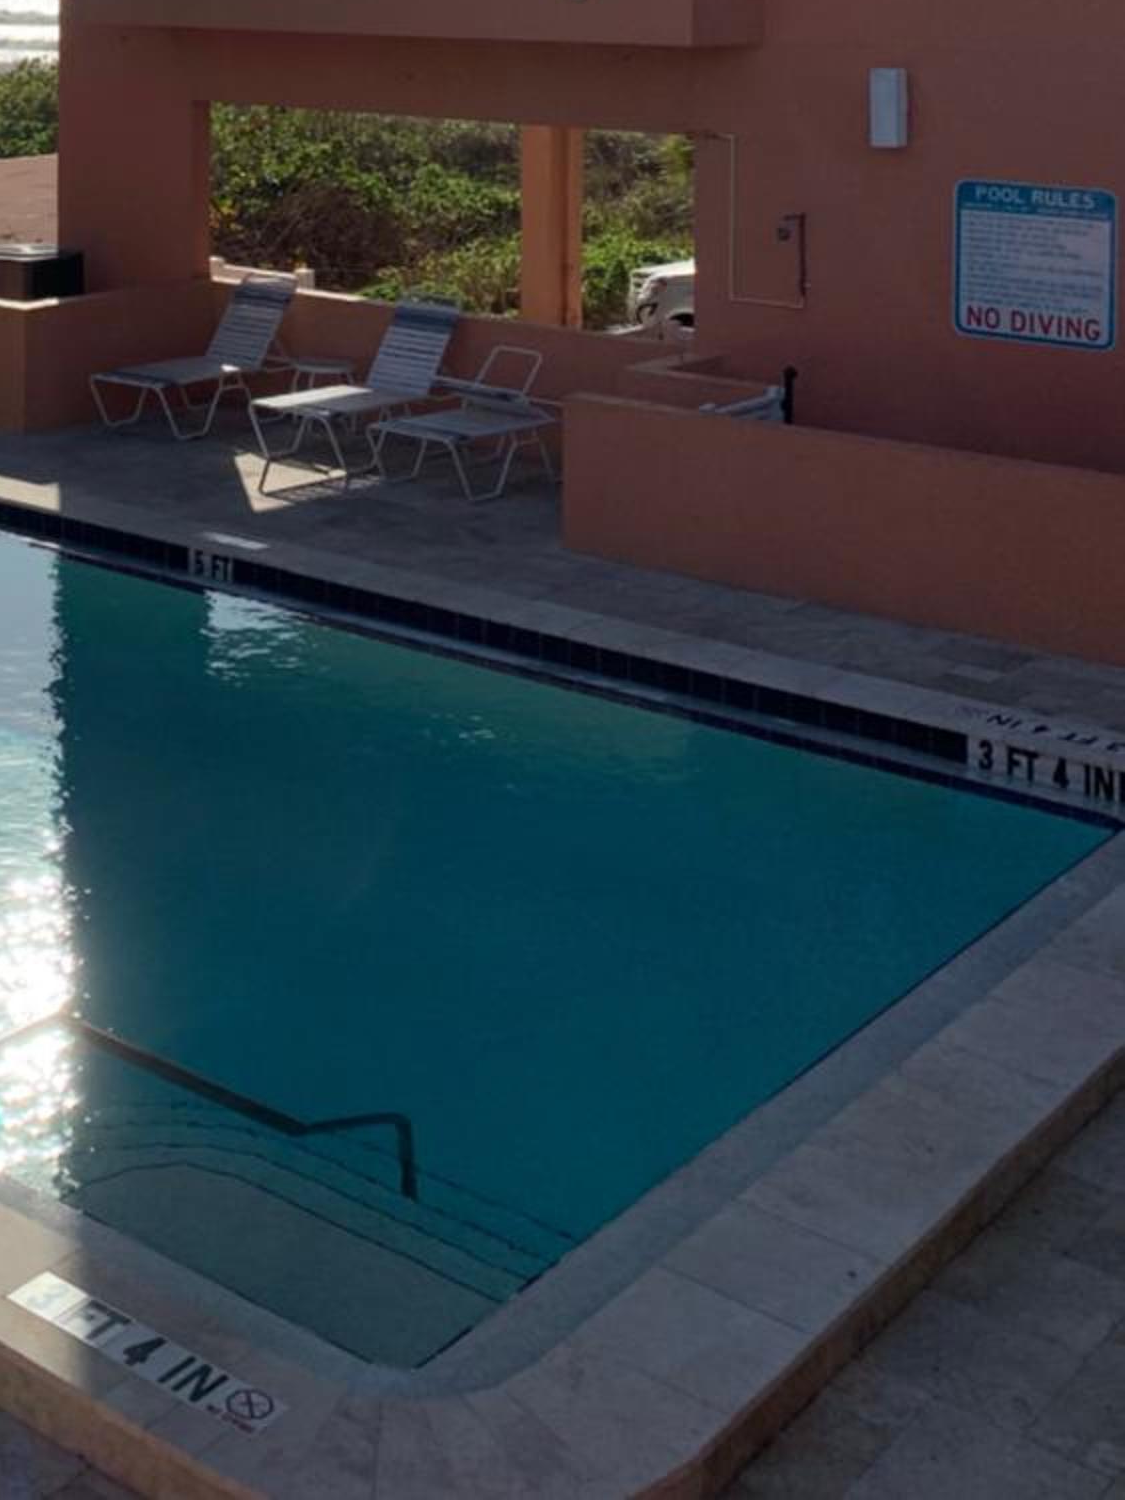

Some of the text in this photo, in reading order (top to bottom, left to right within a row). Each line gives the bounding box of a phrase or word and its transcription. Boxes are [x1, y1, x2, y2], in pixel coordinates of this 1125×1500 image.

[975, 185, 1096, 209] POOL RULES
[966, 304, 1101, 341] NO DIVING
[211, 554, 229, 581] FT
[978, 739, 1115, 802] 3 FT 4 IN
[122, 1335, 167, 1366] 4
[156, 1355, 229, 1403] IN
